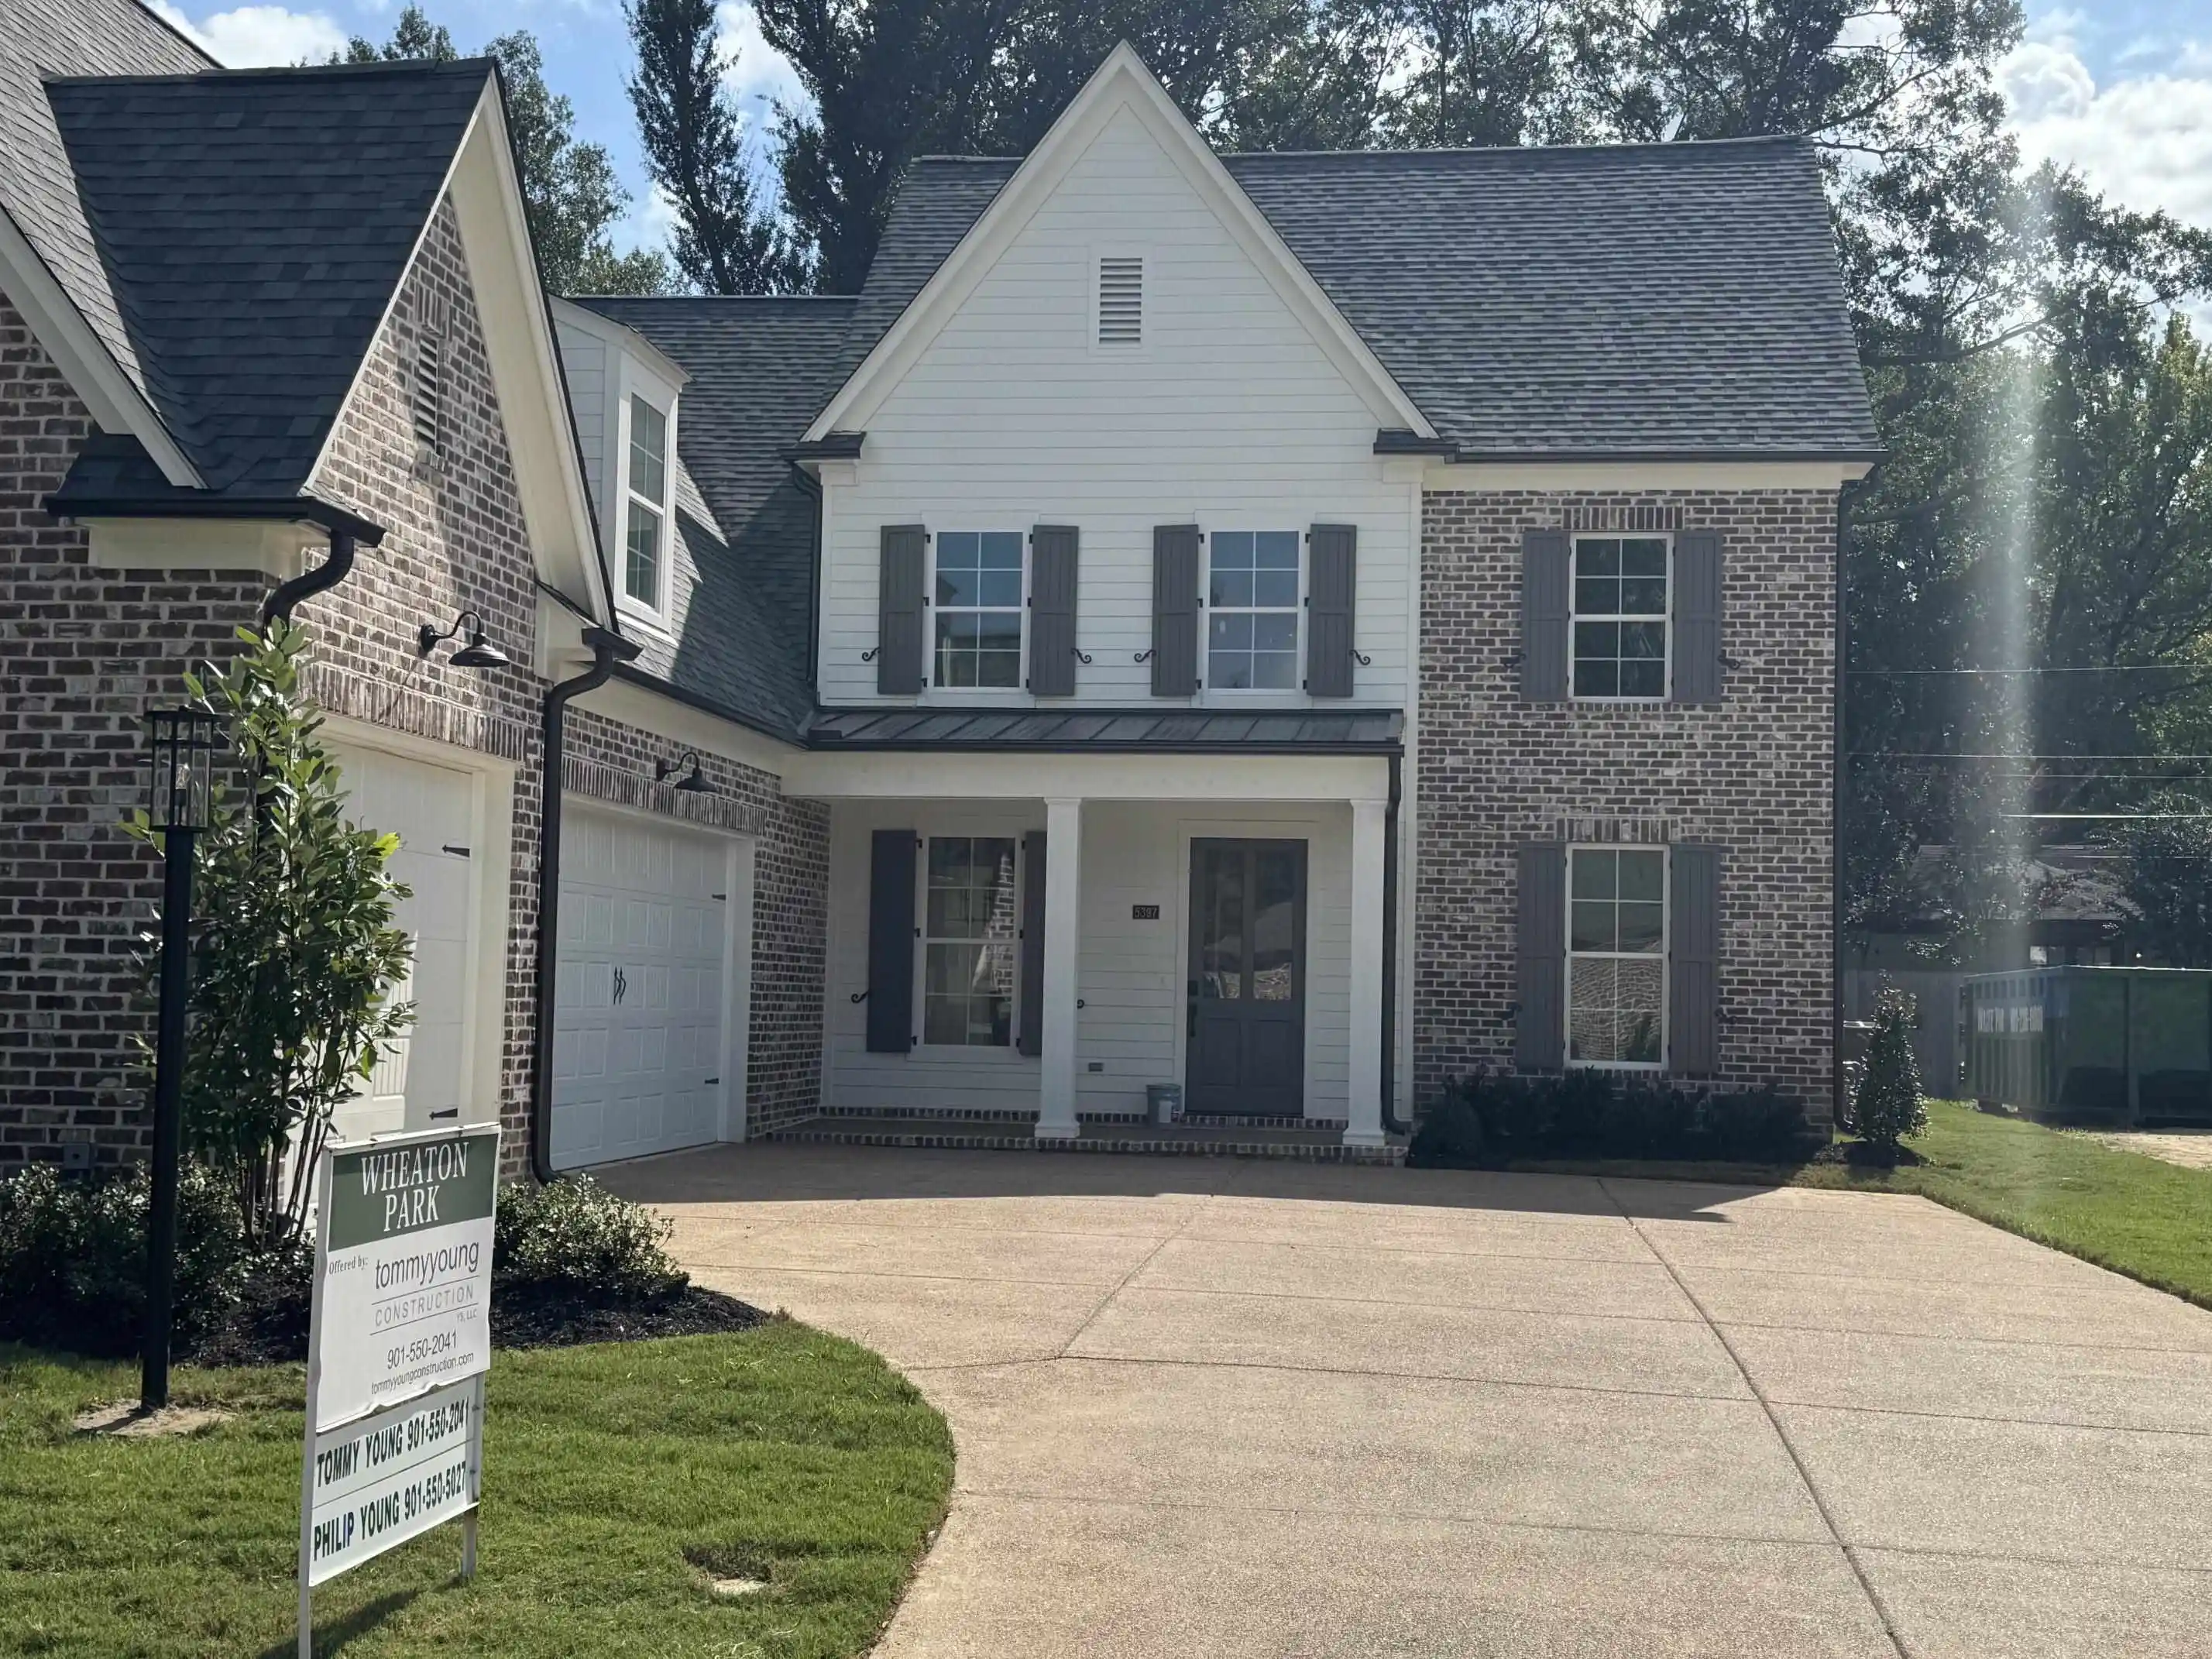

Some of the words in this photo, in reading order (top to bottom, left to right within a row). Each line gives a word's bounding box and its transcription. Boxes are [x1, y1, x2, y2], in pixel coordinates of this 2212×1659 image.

[362, 1142, 469, 1196] WHEATON
[383, 1185, 440, 1232] PARK
[329, 1255, 356, 1275] Offered
[358, 1254, 369, 1270] by:
[375, 1242, 479, 1290] tommyyoung
[375, 1284, 474, 1327] CONSTRUCTION
[466, 1308, 477, 1320] LLC
[387, 1330, 457, 1369] 901-550-2041
[372, 1352, 474, 1395] tommyyoungconstruction.com
[317, 1440, 360, 1488] TOMMY
[366, 1423, 403, 1468] YOUNG
[407, 1396, 469, 1451] 901-550-2041
[314, 1510, 355, 1561] PHILIP
[360, 1491, 400, 1540] YOUNG
[404, 1461, 466, 1520] 901-550-5027
